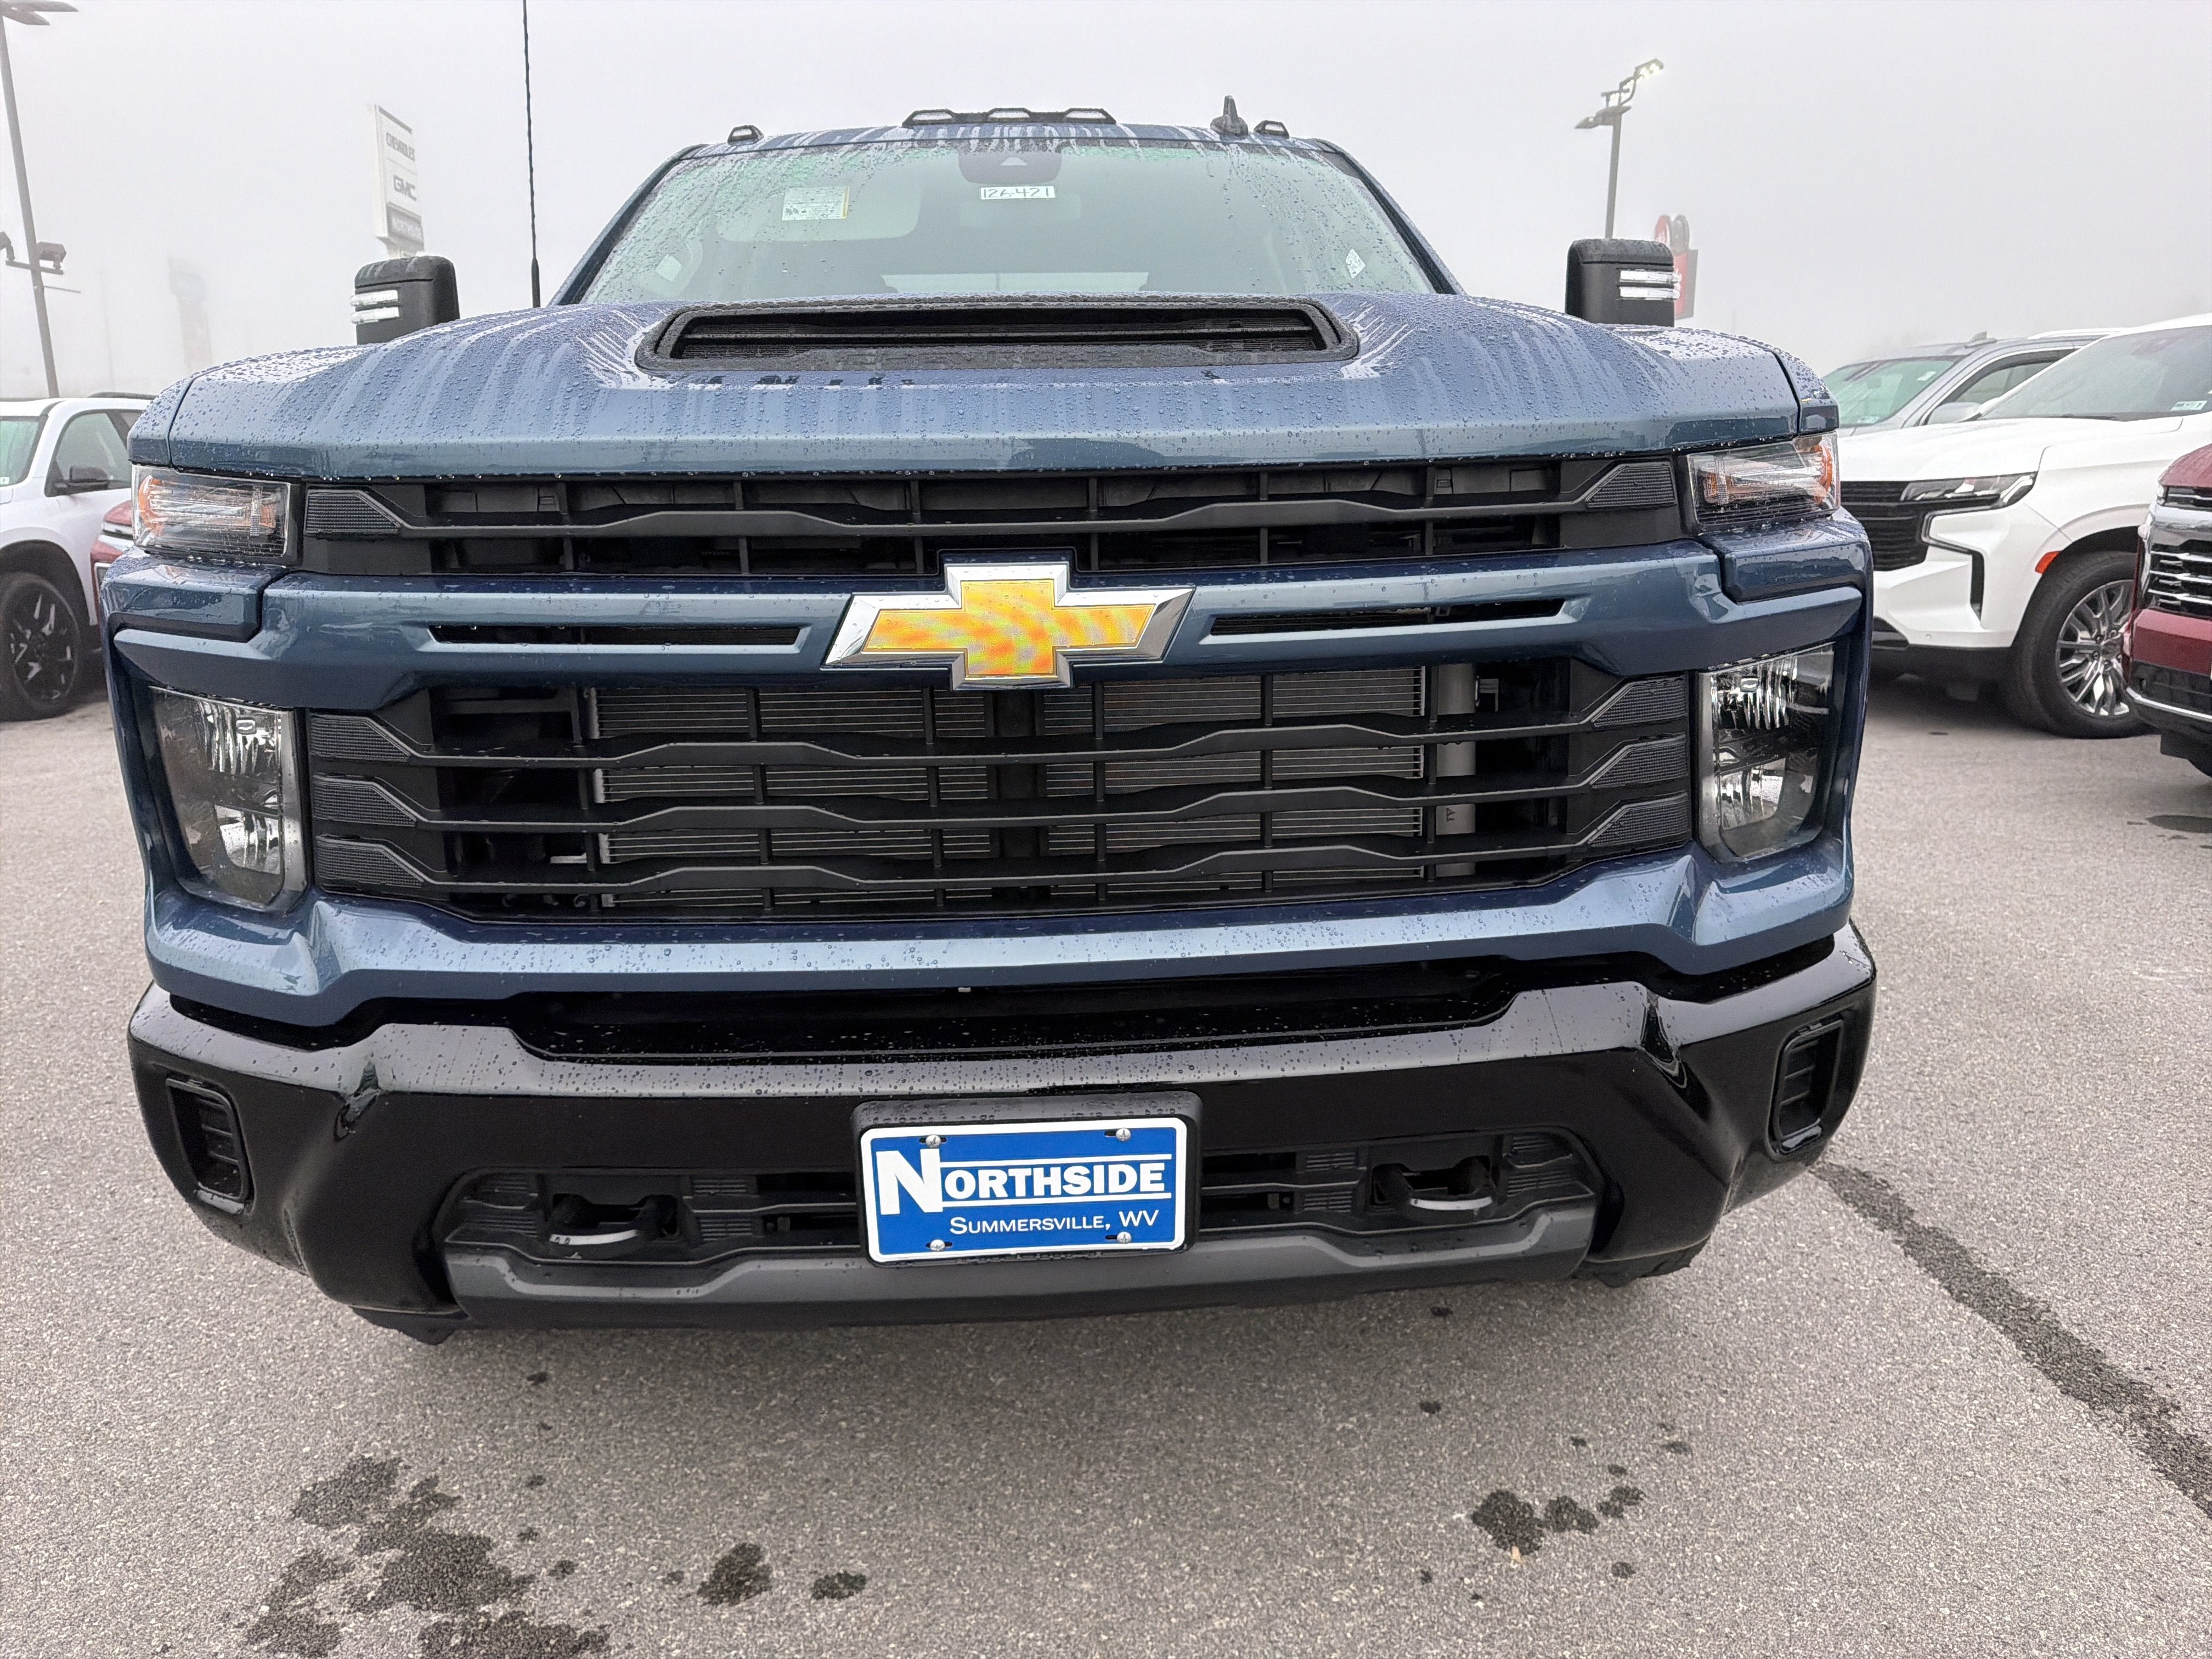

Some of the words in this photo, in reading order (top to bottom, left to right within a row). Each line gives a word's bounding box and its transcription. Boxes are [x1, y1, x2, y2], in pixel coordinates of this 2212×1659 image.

[393, 174, 416, 201] GMC
[984, 187, 1049, 198] 126-421
[876, 1148, 1165, 1215] NORTHSIDE
[950, 1216, 1110, 1234] SUMMERSVILLE,
[1119, 1209, 1159, 1227] WV
